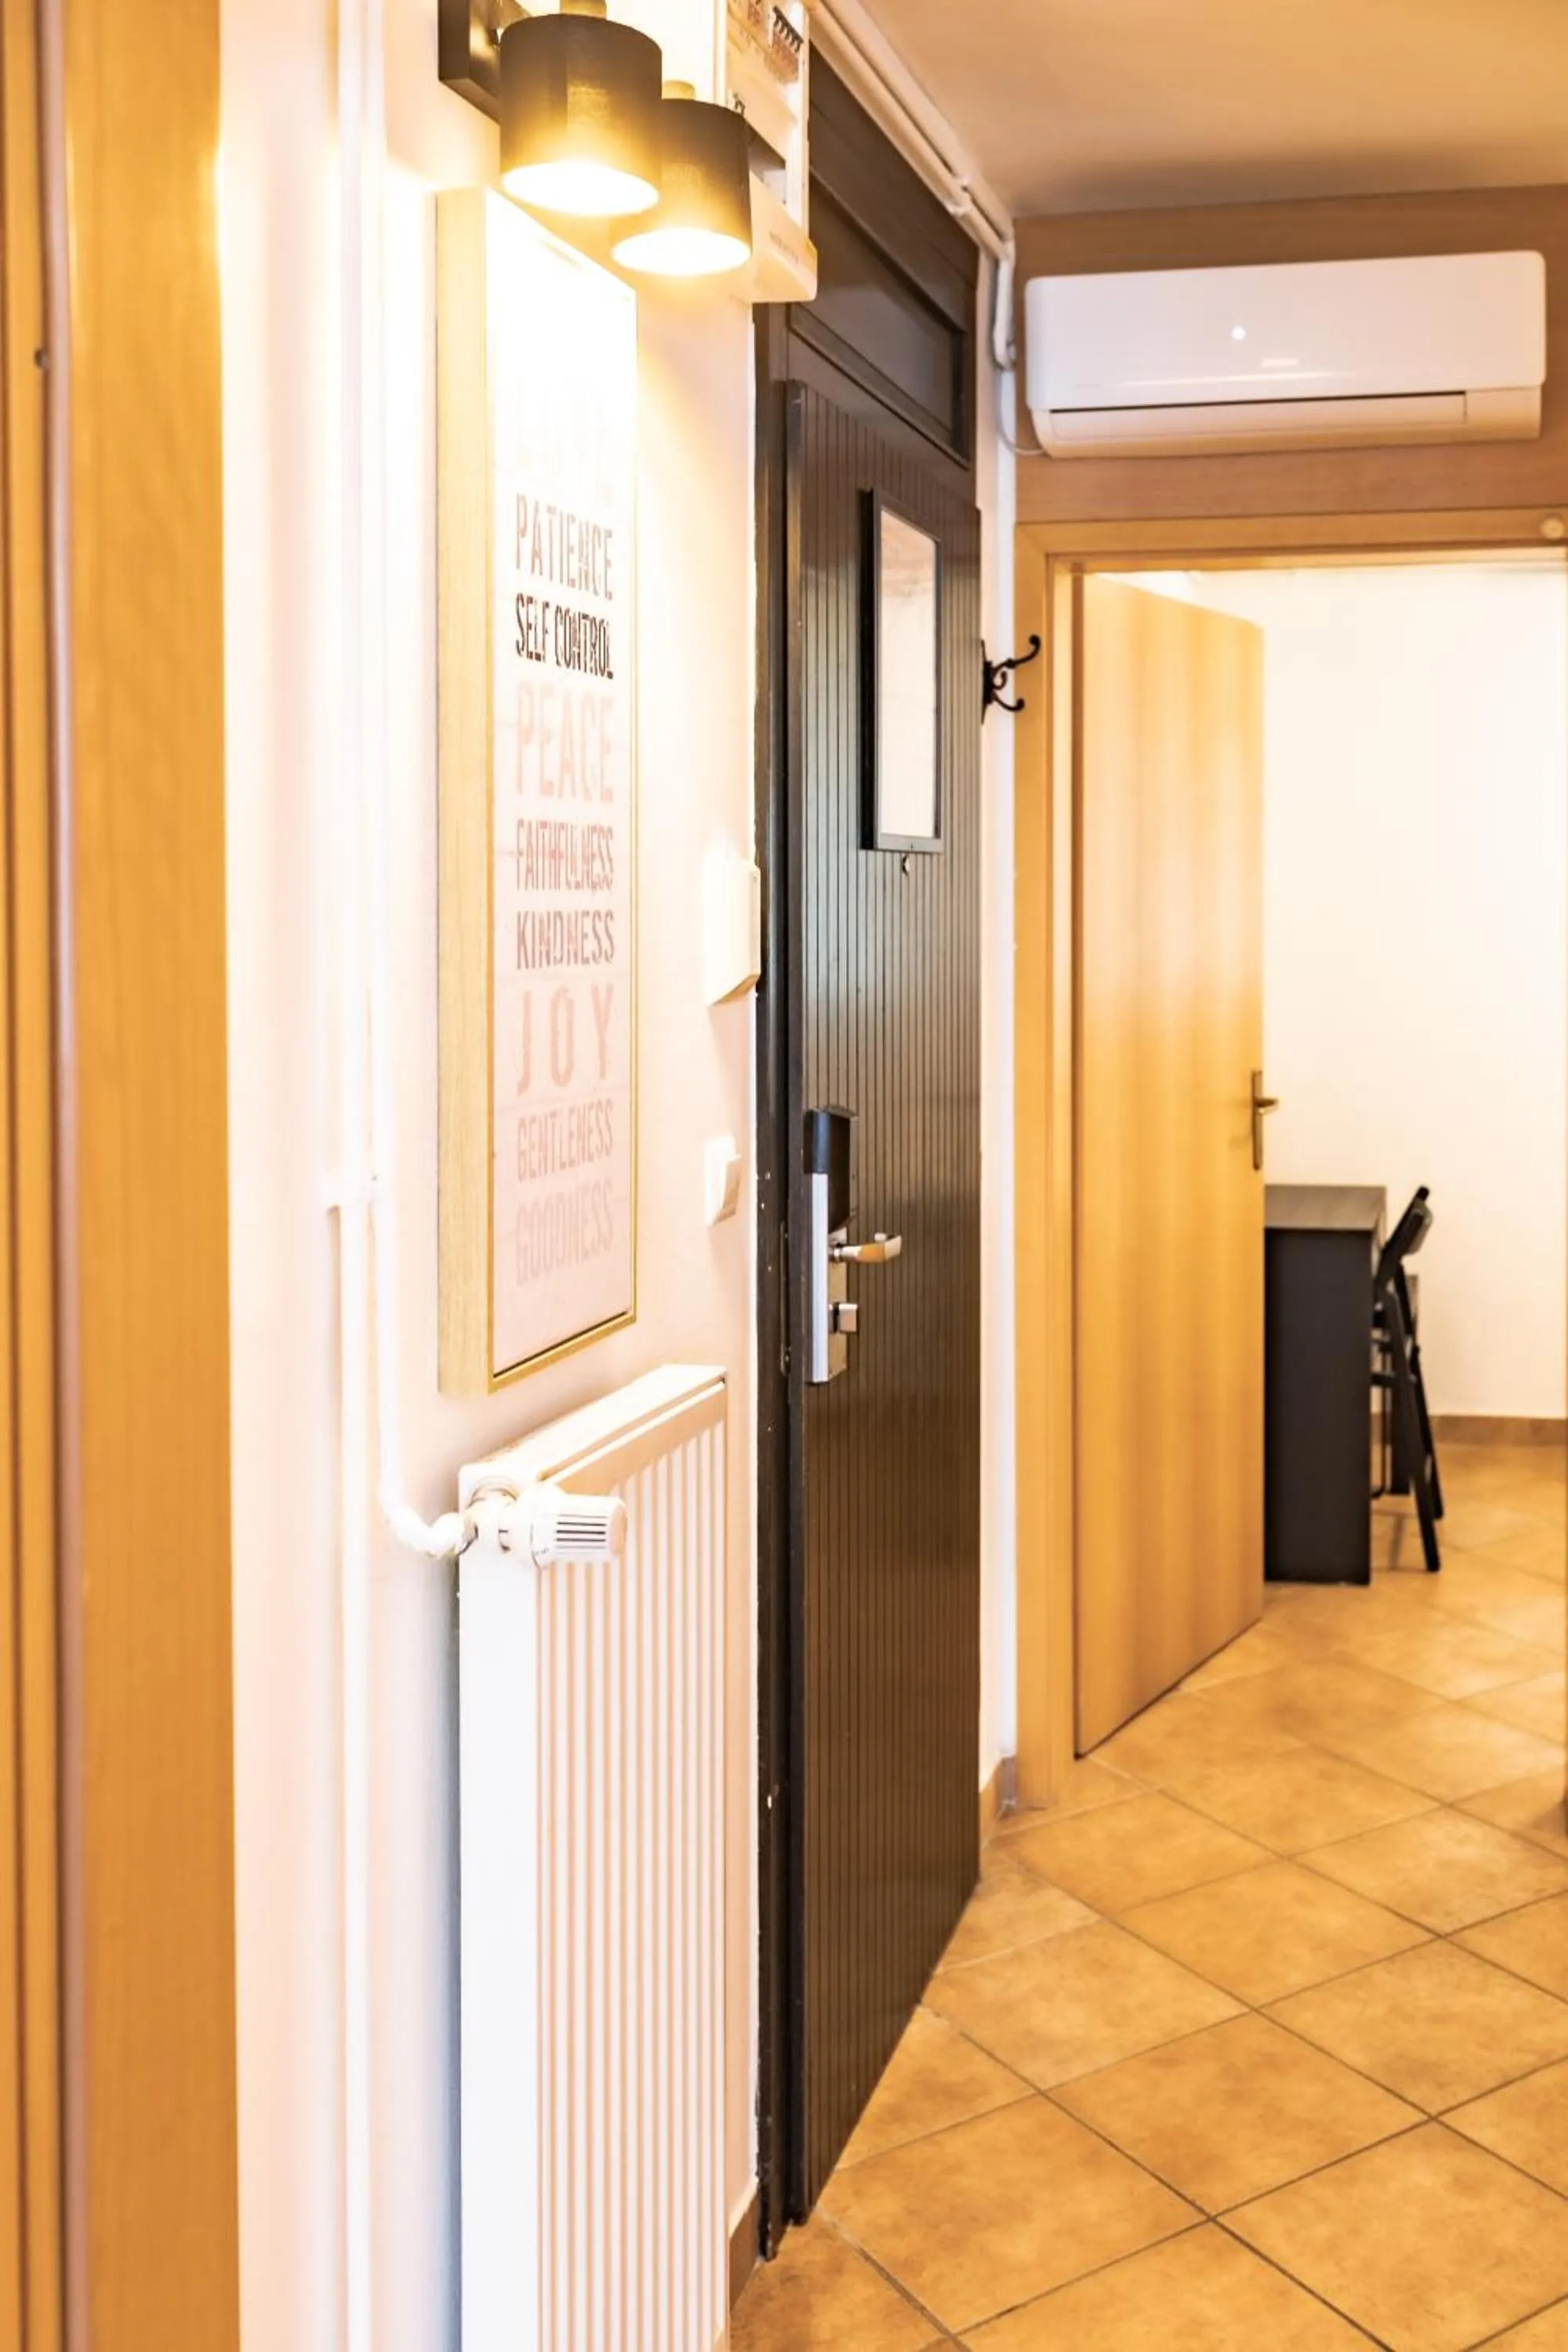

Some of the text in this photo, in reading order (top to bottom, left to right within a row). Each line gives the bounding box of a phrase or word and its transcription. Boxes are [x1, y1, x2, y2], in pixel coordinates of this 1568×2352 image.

[516, 492, 613, 601] PATIENCE
[515, 592, 614, 680] SELF CONTROL
[517, 681, 614, 804] PEACE
[516, 818, 614, 892] FAITHFULNESS
[516, 909, 615, 971] KINDNESS
[517, 982, 614, 1096] JOY
[517, 1098, 614, 1182] GENTLENESS
[515, 1178, 614, 1287] GOODNESS
